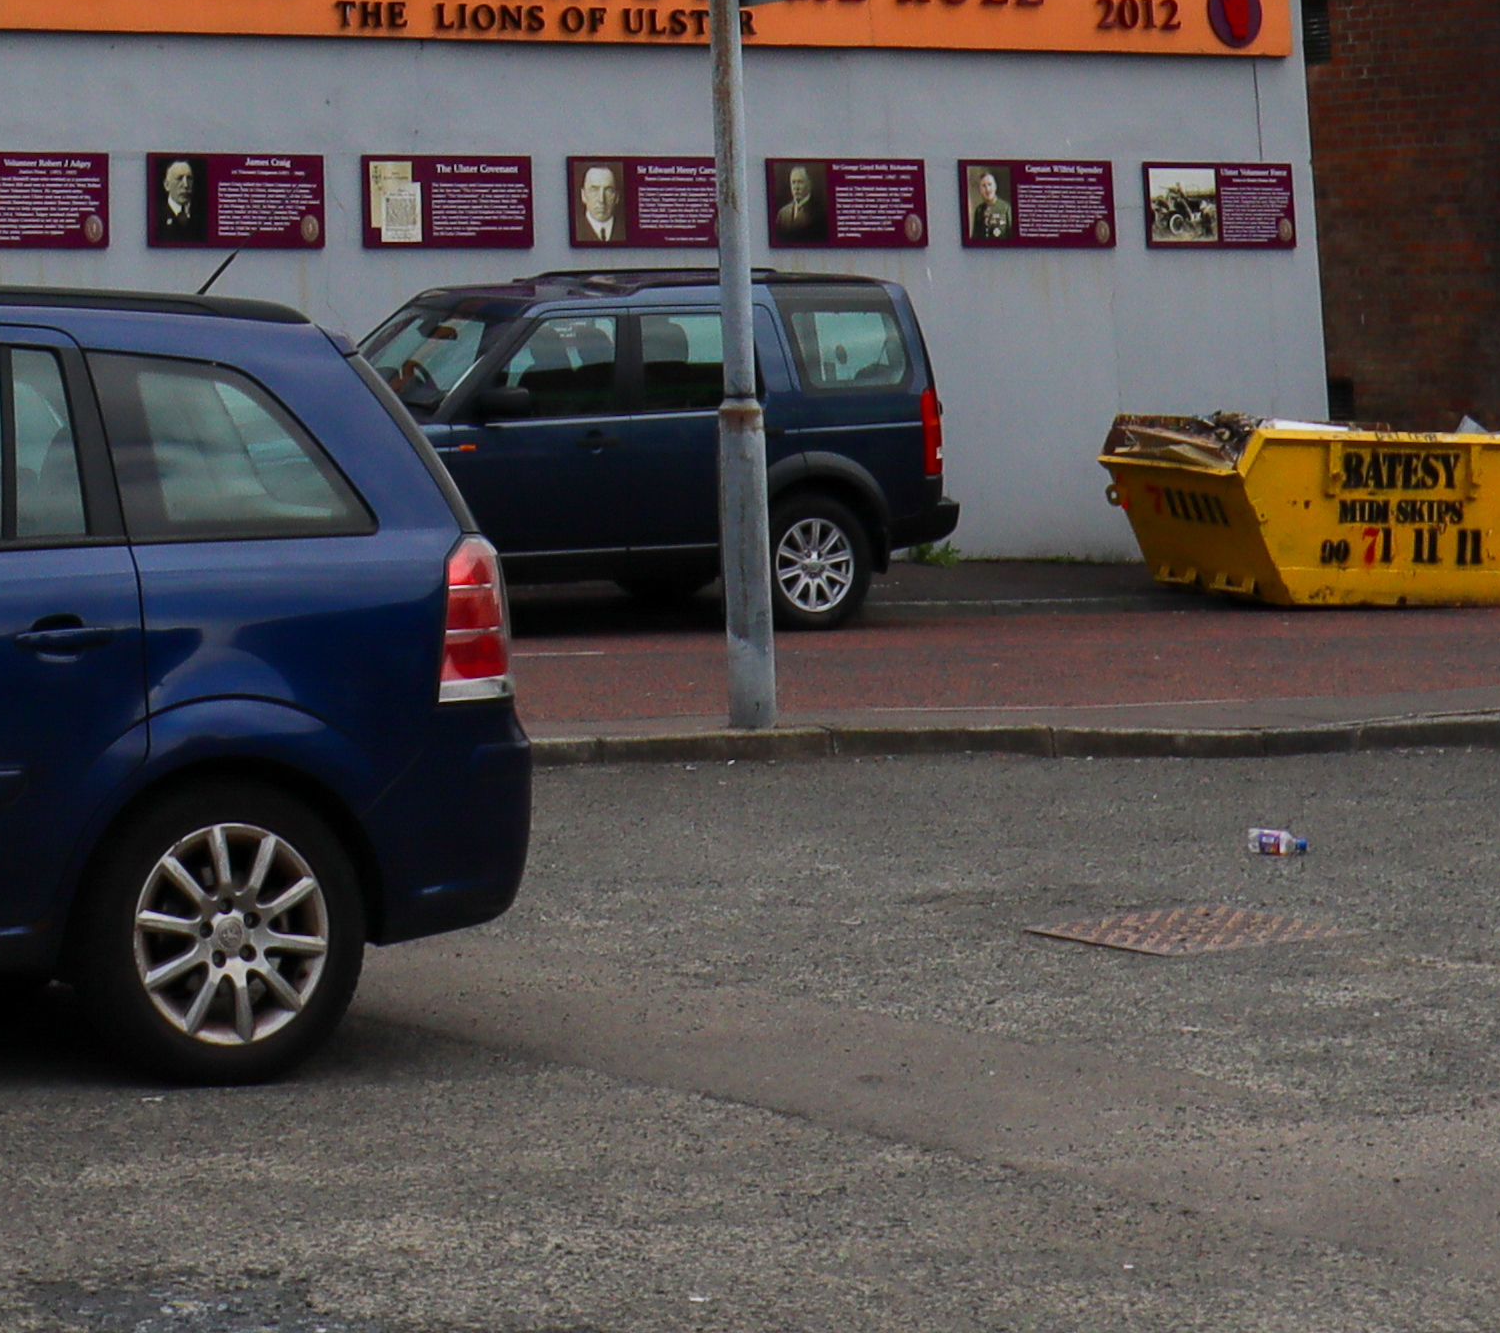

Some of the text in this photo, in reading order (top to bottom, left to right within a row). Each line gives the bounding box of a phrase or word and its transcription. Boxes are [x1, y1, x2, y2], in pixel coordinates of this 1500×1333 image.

[336, 0, 757, 36] THE LIONS OF ULSTR
[245, 157, 292, 168] James Craig
[436, 164, 519, 174] The Ulster Covenant
[1341, 451, 1461, 491] BATESY
[1339, 499, 1464, 525] MIDI SKIPS
[1362, 527, 1393, 566] 71
[1412, 527, 1441, 564] 11
[1456, 529, 1484, 565] 11
